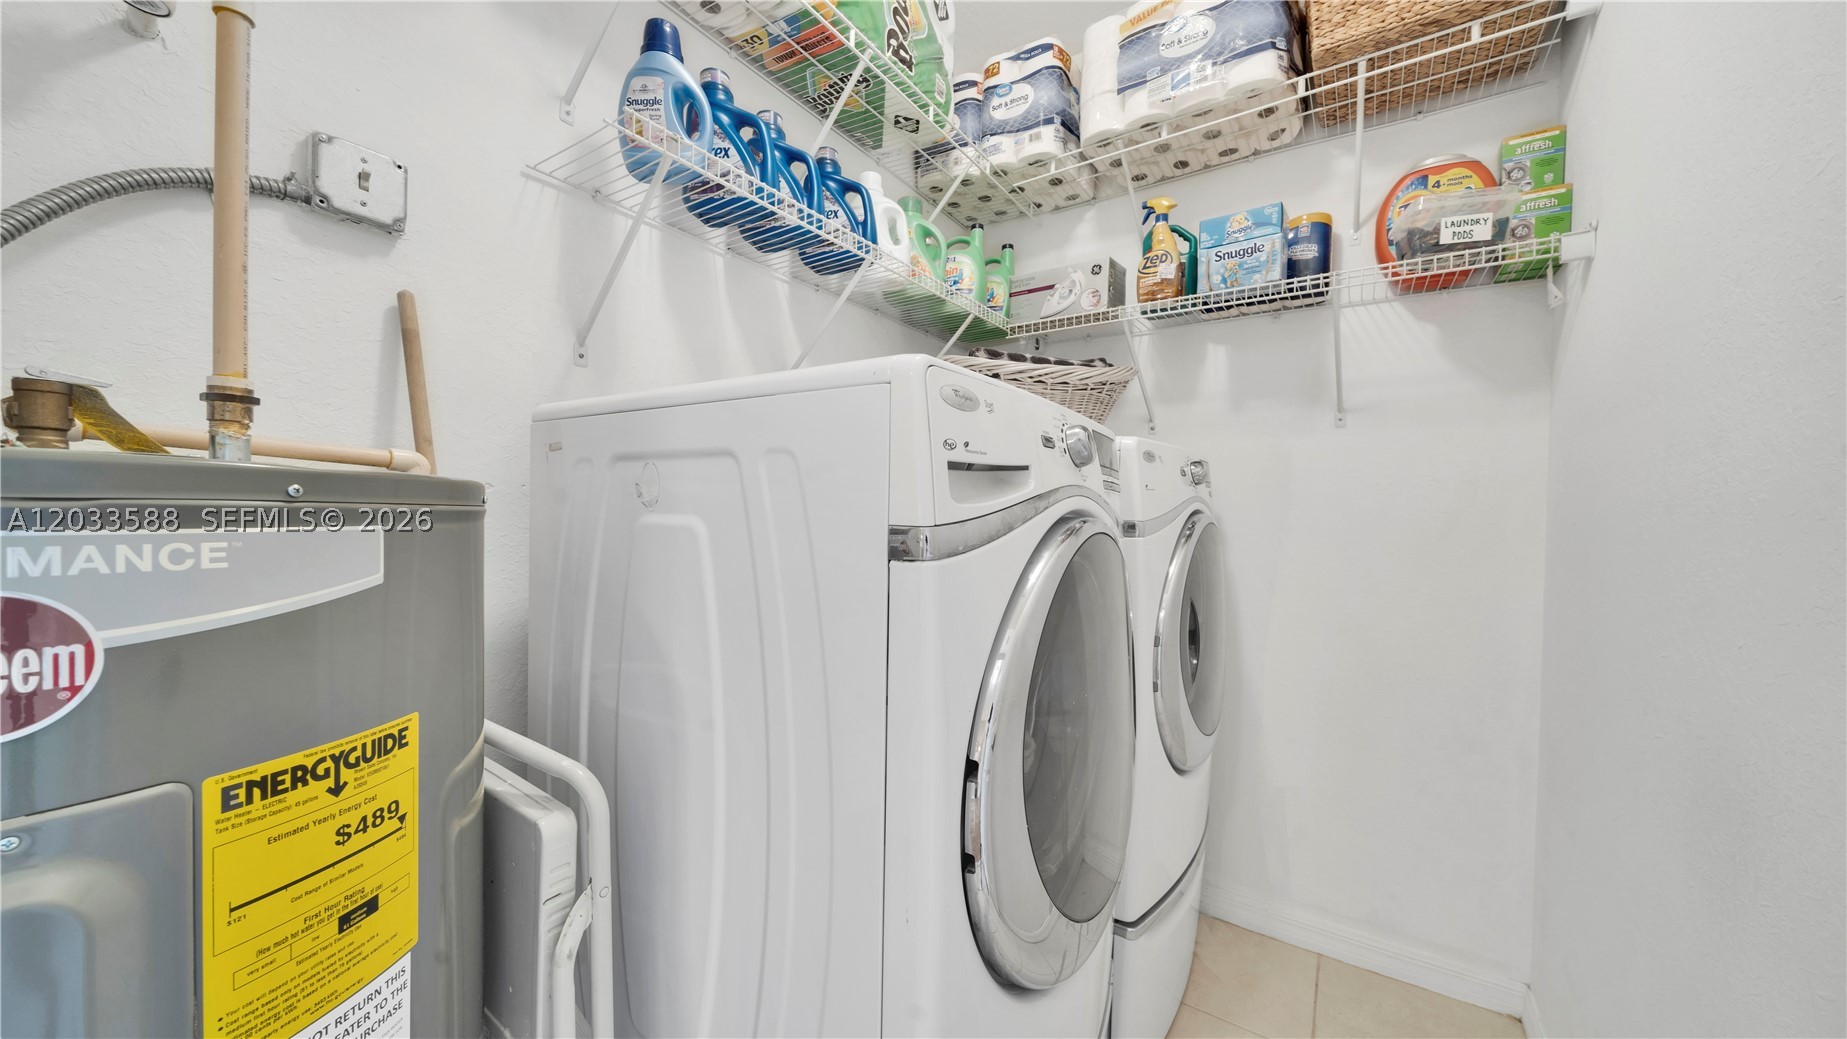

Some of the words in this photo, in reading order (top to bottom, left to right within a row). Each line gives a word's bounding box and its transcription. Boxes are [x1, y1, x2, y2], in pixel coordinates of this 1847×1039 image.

[626, 97, 662, 107] Snuggle
[991, 103, 1003, 112] Soft
[1010, 94, 1029, 106] Strong
[1515, 140, 1552, 155] affresh
[1447, 174, 1473, 183] months
[1520, 197, 1558, 212] affresh
[1226, 223, 1253, 238] Snuggle
[1445, 217, 1490, 229] LAUNDRY
[1452, 230, 1474, 240] PODS
[1214, 242, 1265, 262] Snuggle
[221, 726, 409, 814] ENERGYGUIDE
[228, 769, 258, 781] Government
[215, 817, 232, 825] Water
[234, 810, 252, 819] Heater
[262, 797, 287, 810] ELECTRIC
[215, 826, 229, 835] Tank
[231, 822, 243, 830] Size
[245, 813, 267, 825] (Storage
[302, 795, 319, 805] gallons
[267, 823, 310, 845] Estimated
[312, 812, 337, 827] Yearly
[338, 802, 362, 816] Energy
[364, 794, 378, 805] Cost
[334, 799, 400, 847] $489
[290, 893, 303, 903] Cost
[304, 886, 322, 897] Range
[329, 871, 346, 886] Similar
[348, 863, 364, 874] Models
[303, 911, 322, 925] First
[324, 899, 342, 914] Hour
[344, 887, 366, 902] Rating
[226, 914, 247, 927] $121
[256, 947, 271, 958] (How
[273, 936, 289, 949] much
[290, 929, 300, 941] hot
[300, 921, 316, 934] water
[316, 917, 326, 927] you
[327, 913, 335, 923] get
[247, 968, 259, 976] very
[261, 958, 277, 969] small
[296, 948, 318, 967] Estimated
[320, 940, 333, 952] Yearly
[225, 1018, 239, 1028] Cost
[241, 1007, 259, 1019] range
[261, 995, 278, 1008] based
[280, 988, 292, 998] only
[301, 971, 321, 984] models
[226, 1007, 240, 1017] Your
[242, 999, 254, 1009] cost
[256, 992, 266, 1001] will
[268, 980, 288, 995] depend
[298, 969, 309, 978] your
[260, 1011, 281, 1025] energy
[282, 1002, 295, 1012] cost
[302, 987, 318, 1000] based
[332, 967, 351, 981] national
[335, 986, 382, 1028] RETURN
[384, 966, 406, 989] THIS
[374, 998, 388, 1014] TO
[390, 979, 408, 1000] THE
[225, 1019, 252, 1036] medium
[254, 1011, 265, 1020] first
[267, 1002, 280, 1013] hour
[282, 993, 298, 1005] rating
[255, 1022, 272, 1034] cents
[280, 1014, 300, 1029] energy
